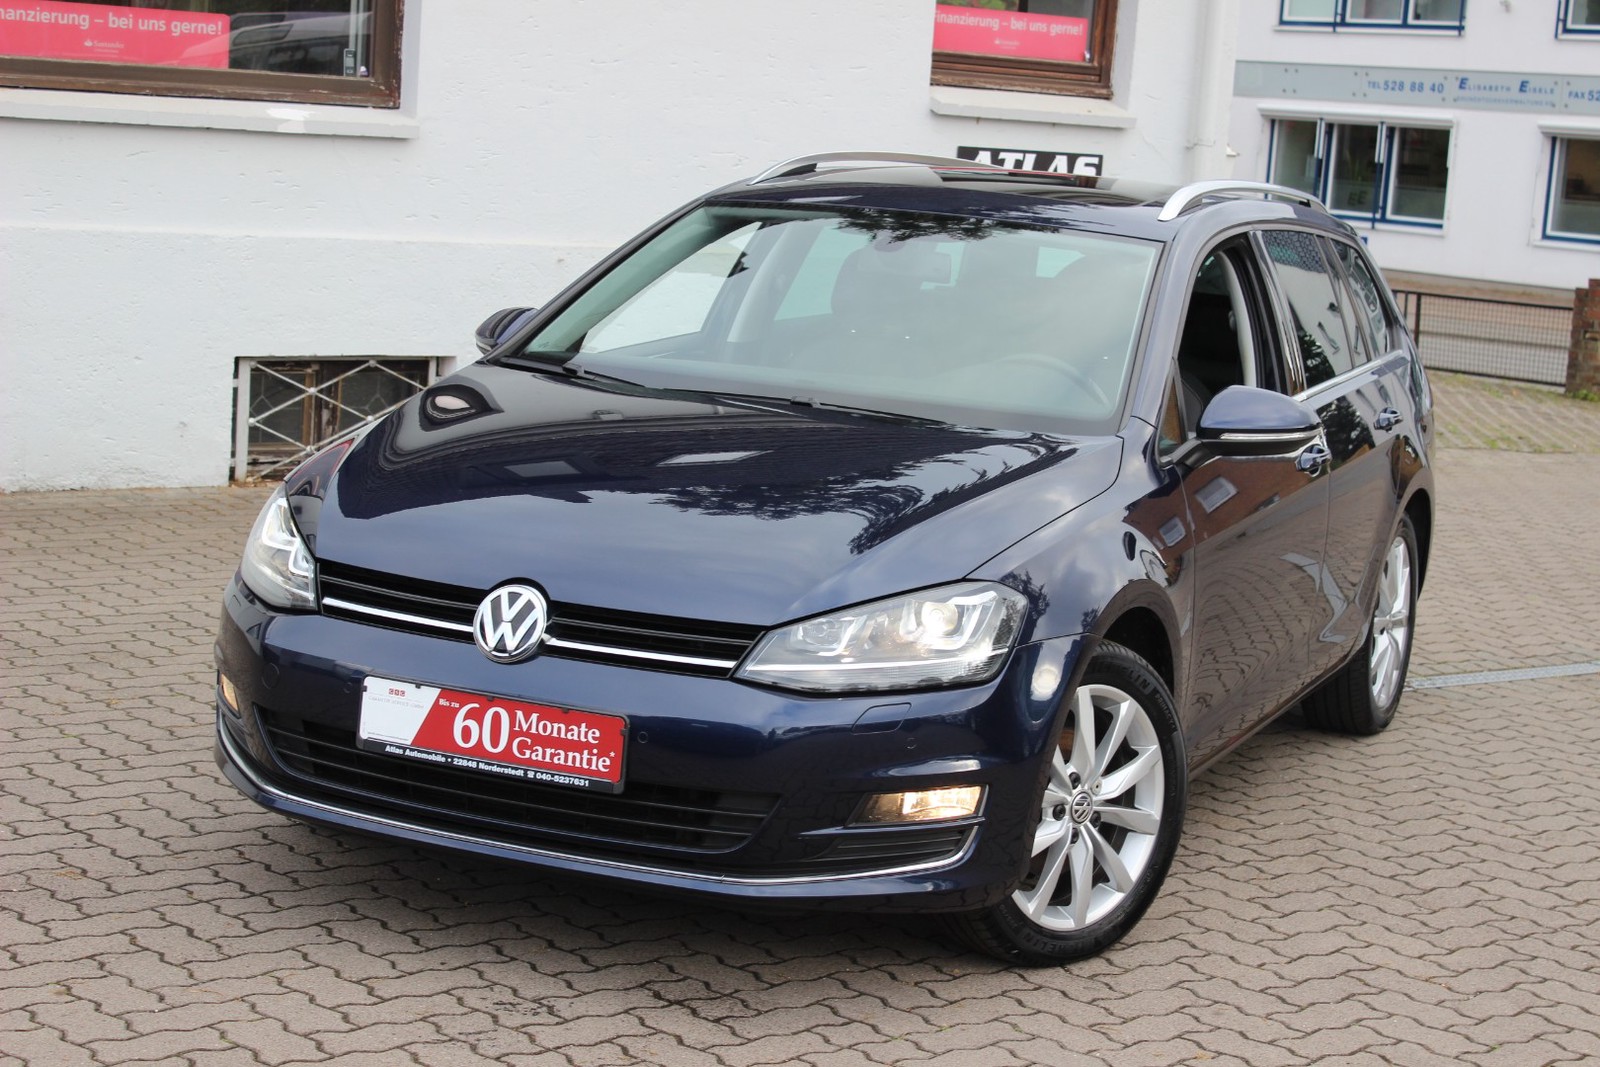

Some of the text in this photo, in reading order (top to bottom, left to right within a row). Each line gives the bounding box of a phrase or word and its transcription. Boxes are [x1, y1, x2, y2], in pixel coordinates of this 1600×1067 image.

[108, 12, 133, 29] bei
[138, 18, 166, 32] uns
[171, 20, 222, 36] gerne!
[1010, 17, 1027, 31] bei
[1029, 22, 1047, 33] uns
[1050, 23, 1083, 36] gerne!
[1368, 80, 1444, 94] TEL 528 88 40
[1568, 90, 1585, 99] FAX
[439, 698, 450, 707] Bis
[453, 703, 510, 753] 60
[513, 710, 600, 744] Monate
[385, 744, 403, 755] Atlas
[405, 749, 445, 763] Automobile
[479, 762, 524, 778] Norderstedt
[536, 772, 589, 787] 040-5237631
